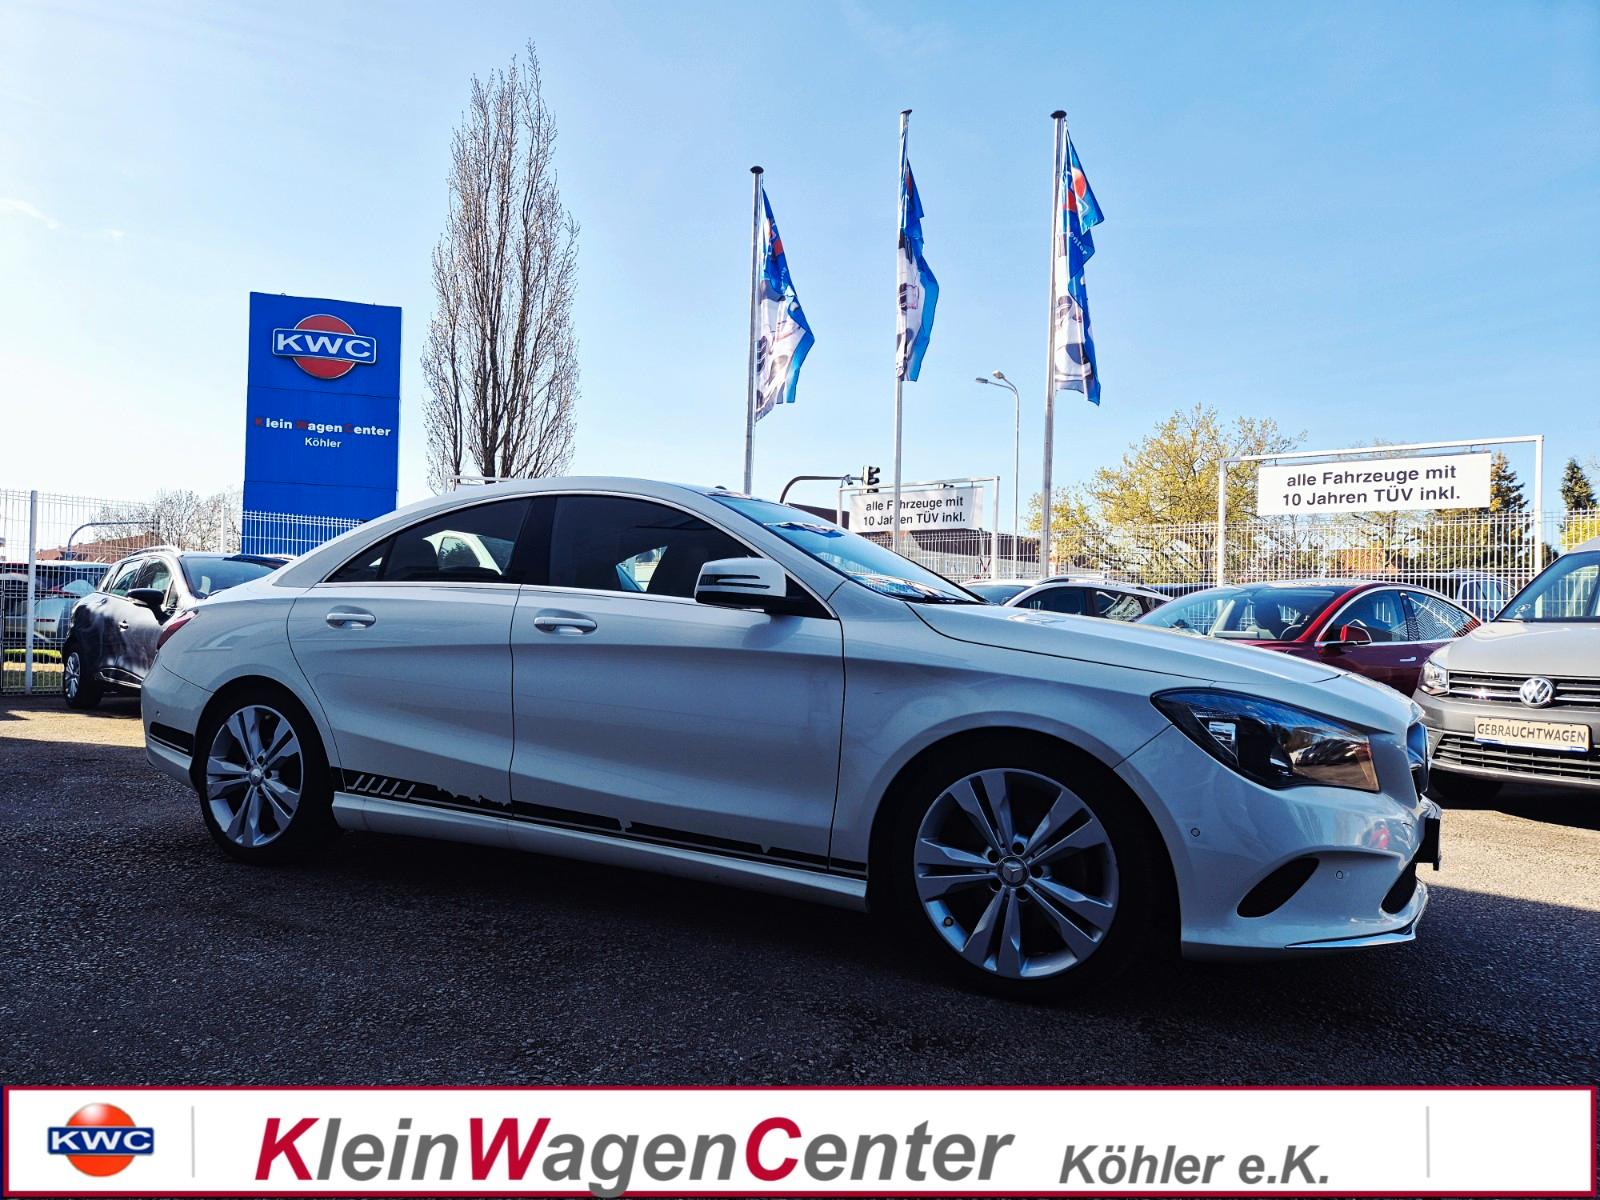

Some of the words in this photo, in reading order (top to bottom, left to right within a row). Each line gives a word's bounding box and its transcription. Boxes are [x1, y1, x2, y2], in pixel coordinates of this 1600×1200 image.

[277, 333, 371, 358] KWC
[305, 437, 342, 448] Köhler
[1287, 473, 1317, 487] alle
[1323, 469, 1419, 485] Fahrzeuge
[1425, 465, 1457, 480] mit
[866, 501, 884, 511] alle
[887, 498, 942, 511] Fhrzeuge
[946, 496, 964, 507] mit
[1283, 493, 1301, 506] 10
[1307, 491, 1367, 505] Jahren
[1374, 485, 1414, 502] TÜV
[1420, 486, 1460, 501] inkl.
[864, 516, 875, 526] 10
[877, 515, 913, 525] Jahen
[916, 510, 939, 523] TÜV
[942, 511, 966, 523] inkl.
[1477, 723, 1586, 743] GEBRAUCHTWAGEN
